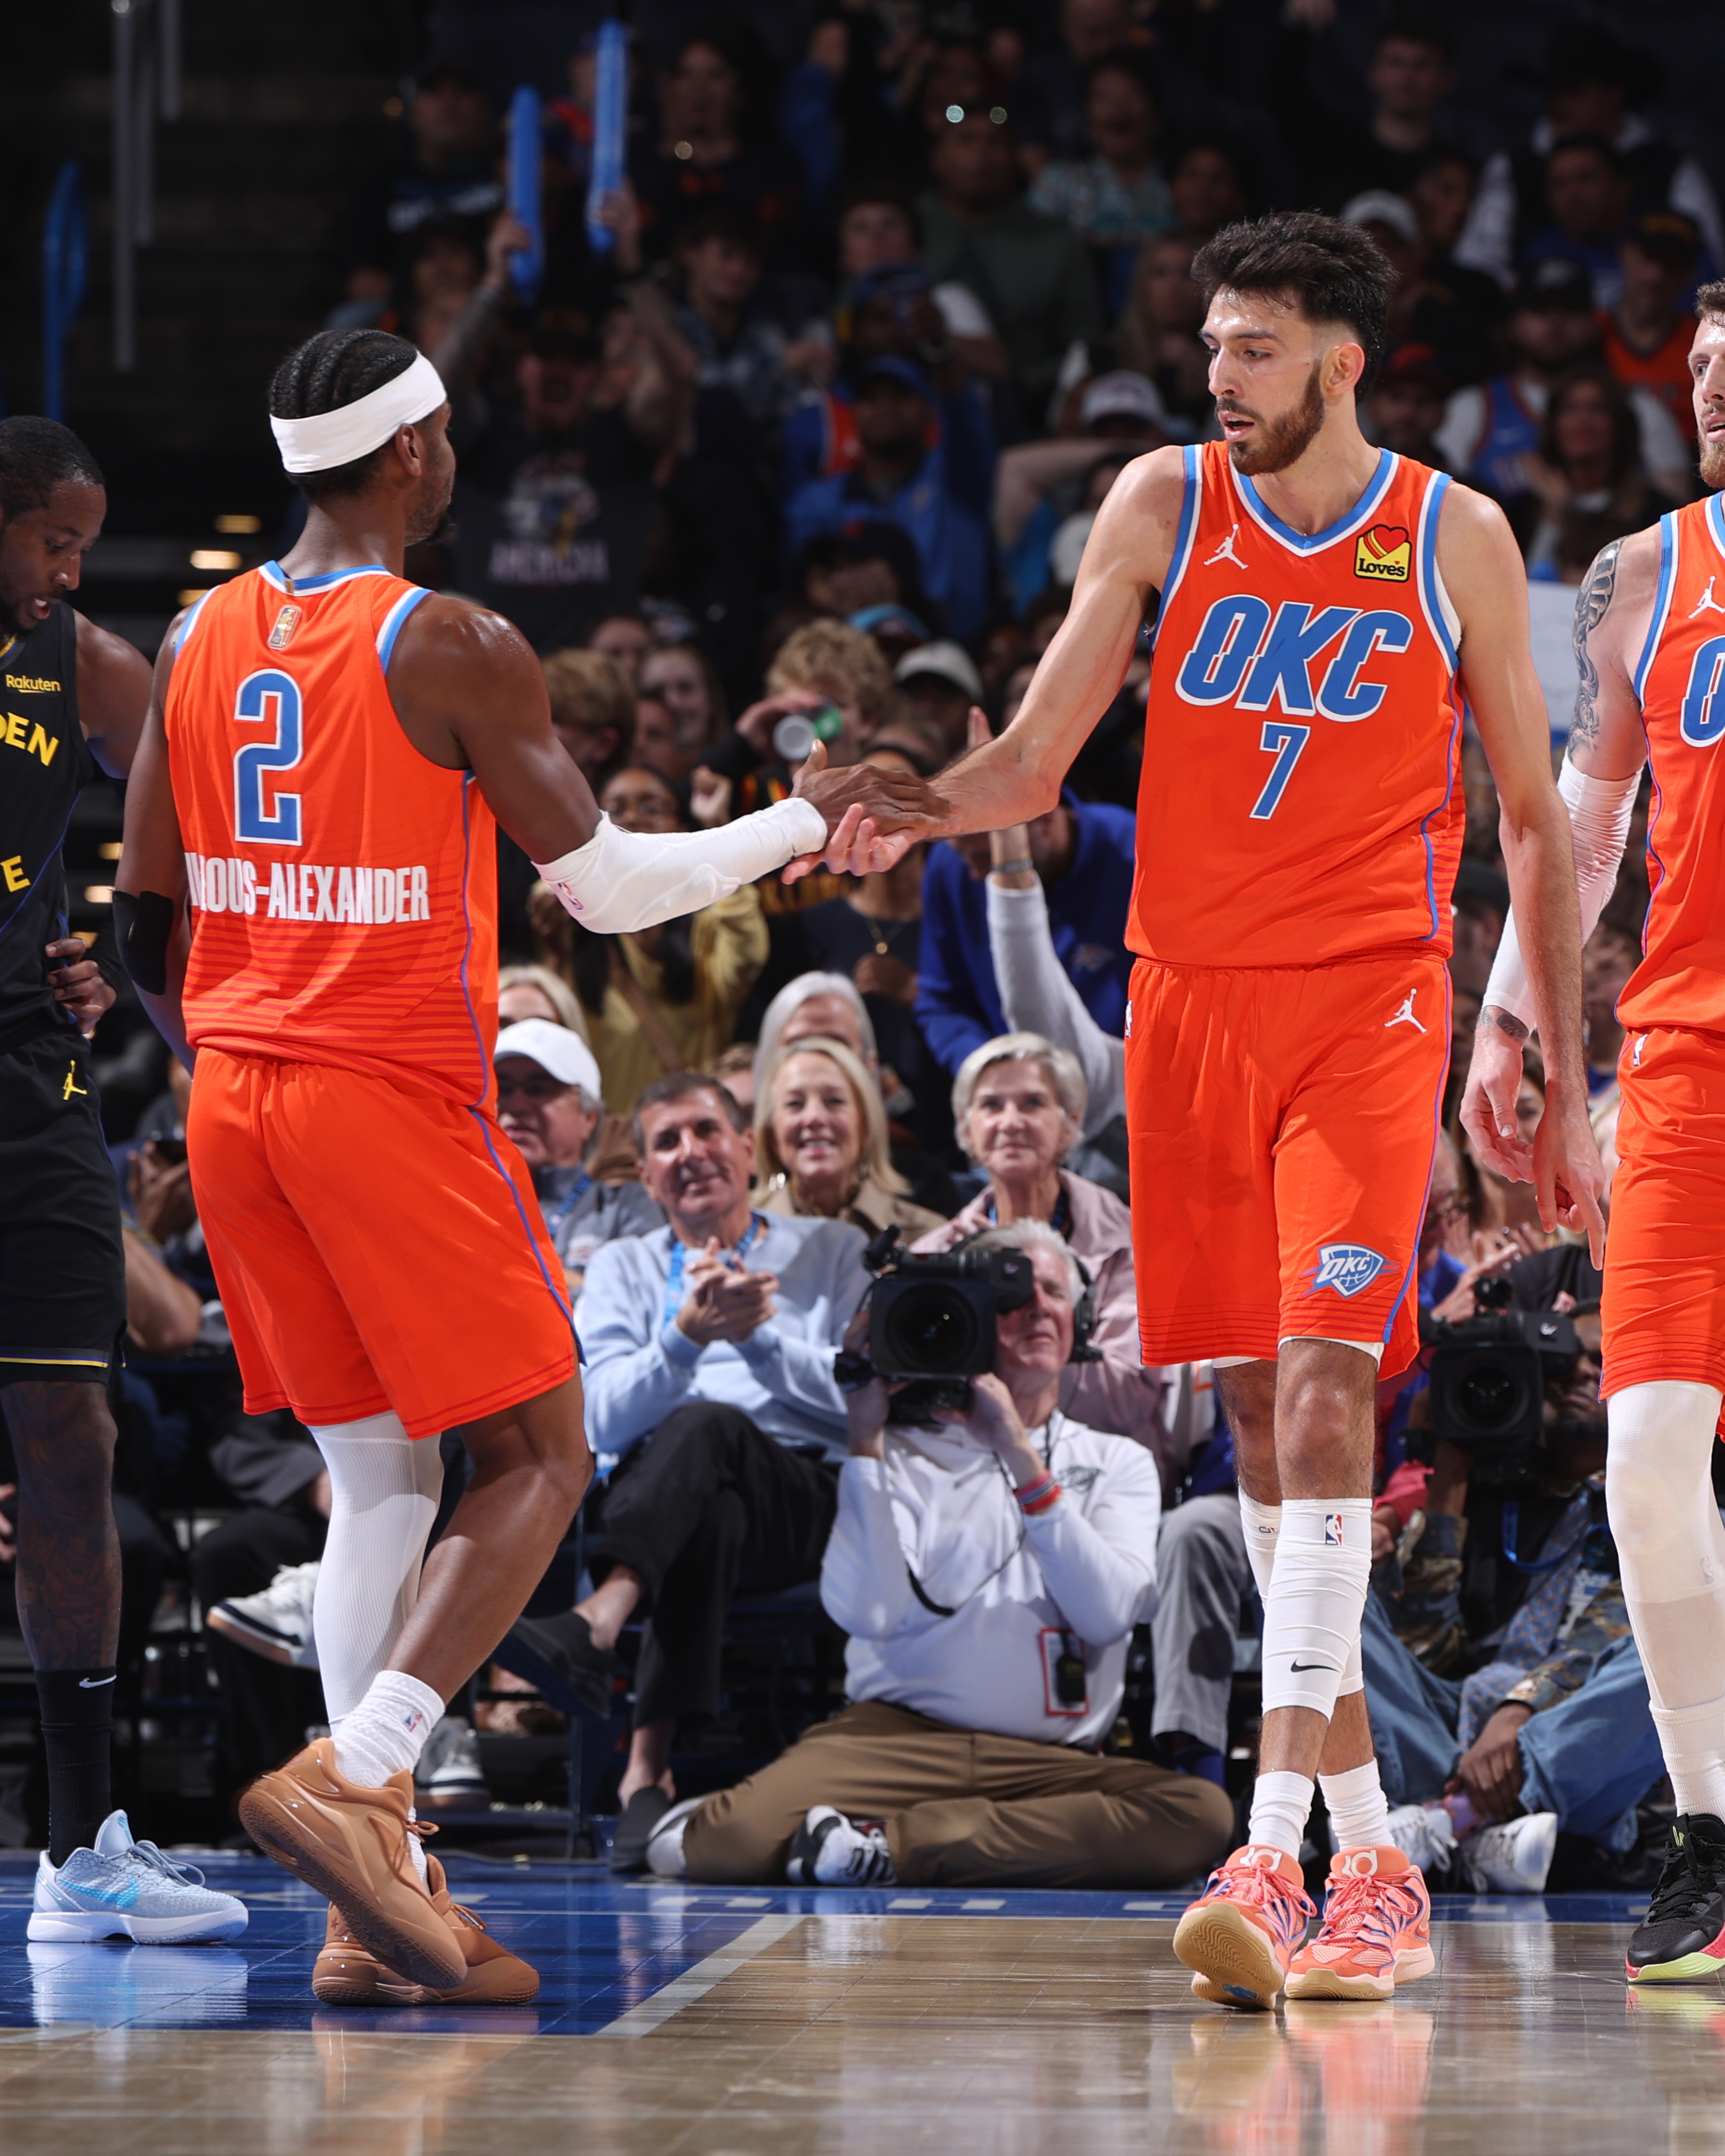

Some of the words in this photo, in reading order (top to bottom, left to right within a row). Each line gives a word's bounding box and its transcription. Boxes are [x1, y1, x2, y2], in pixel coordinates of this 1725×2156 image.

[5, 674, 62, 692] Rakuten
[1175, 594, 1414, 723] OKC
[0, 712, 60, 767] EN
[233, 668, 304, 846] 2
[1249, 721, 1311, 821] 7
[1316, 1256, 1371, 1284] OKC
